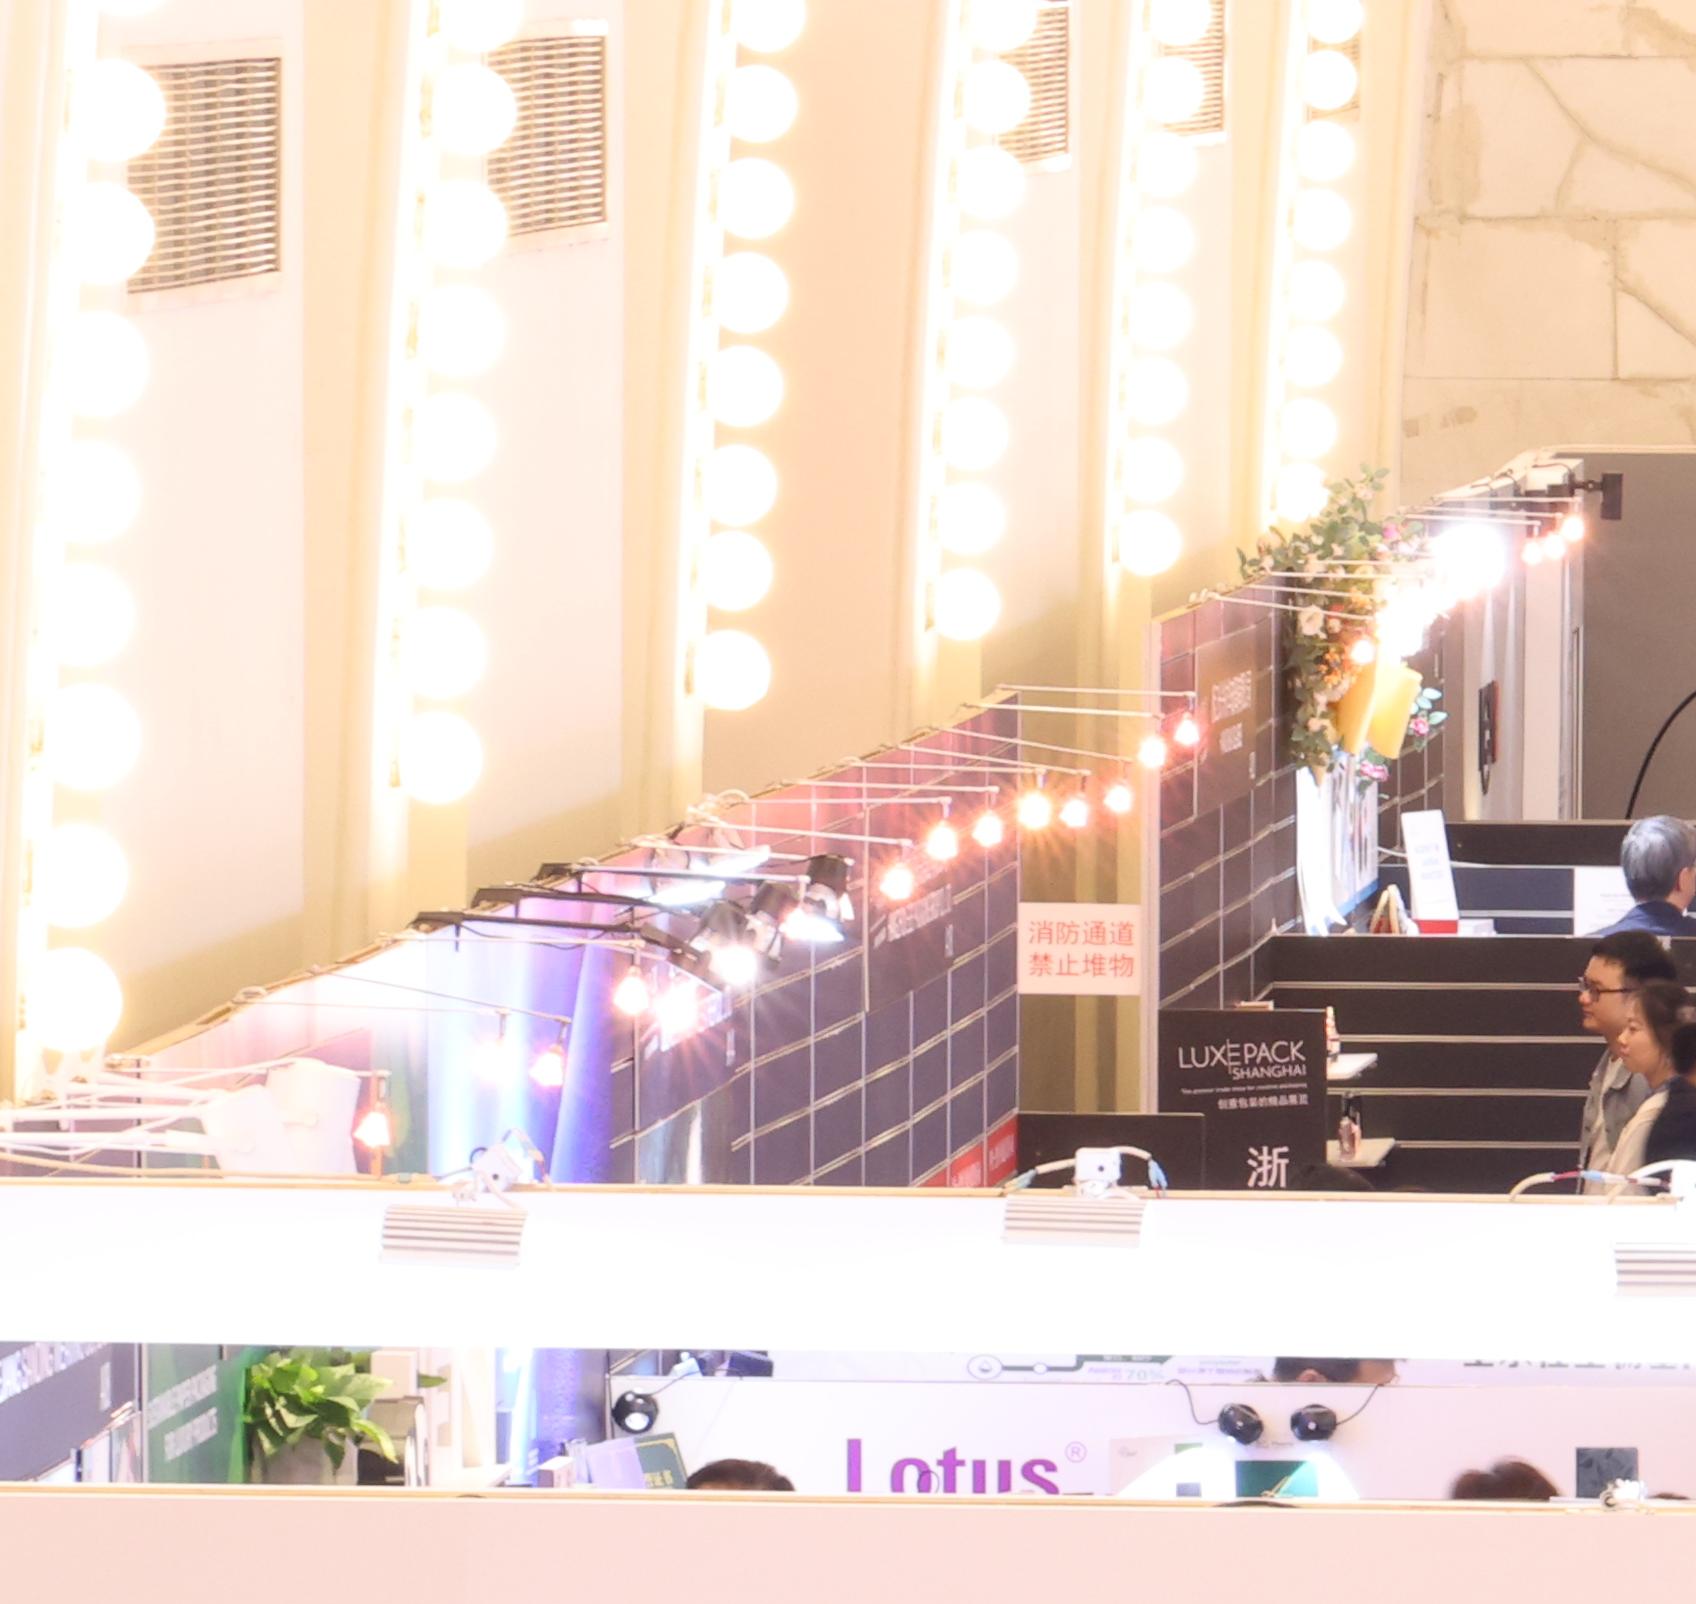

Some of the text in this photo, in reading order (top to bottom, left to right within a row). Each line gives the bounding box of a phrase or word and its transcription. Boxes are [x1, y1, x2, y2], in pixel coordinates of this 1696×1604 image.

[1028, 920, 1135, 947] 消防通道
[1028, 953, 1135, 978] 禁止堆物
[1243, 1040, 1306, 1064] PACK
[1232, 1064, 1307, 1081] SHANGHAI
[1247, 1145, 1289, 1189] 浙
[846, 1438, 1060, 1495] Lotus
